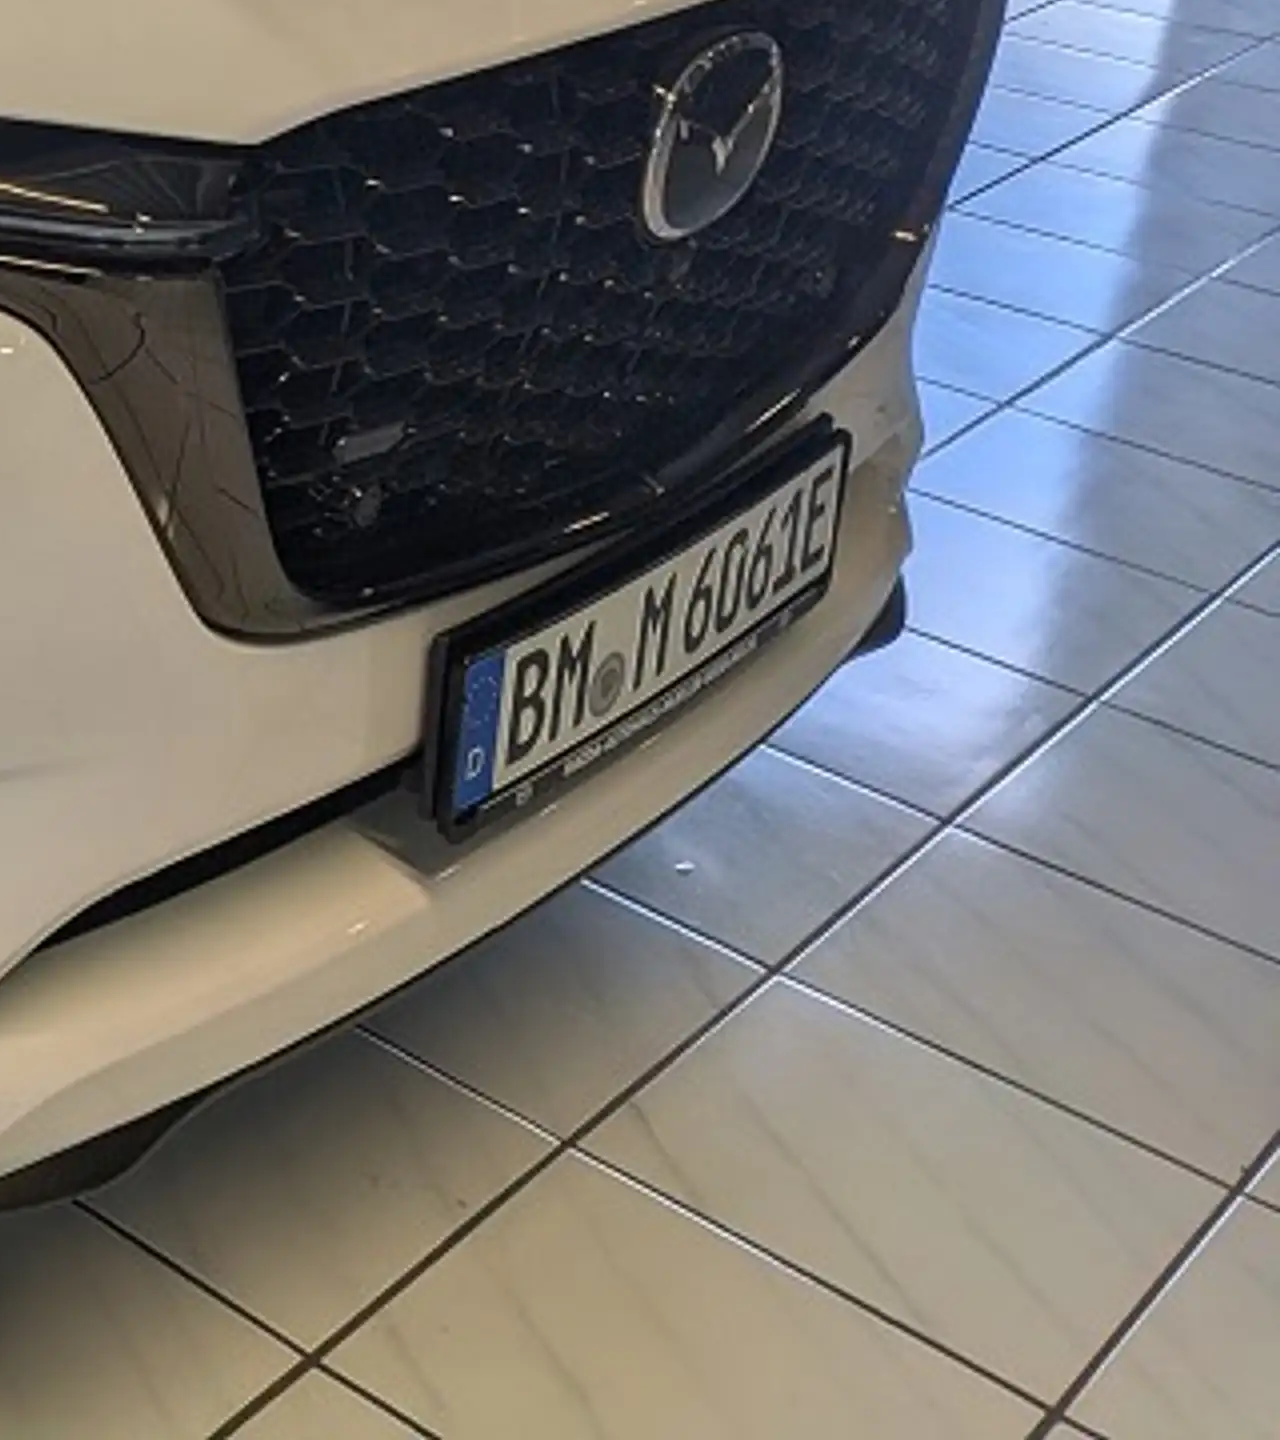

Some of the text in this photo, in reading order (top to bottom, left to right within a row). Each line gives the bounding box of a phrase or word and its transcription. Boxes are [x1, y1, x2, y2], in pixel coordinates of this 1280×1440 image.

[506, 620, 597, 767] BM
[632, 572, 677, 691] M
[683, 468, 835, 655] 6061E
[464, 746, 485, 781] D
